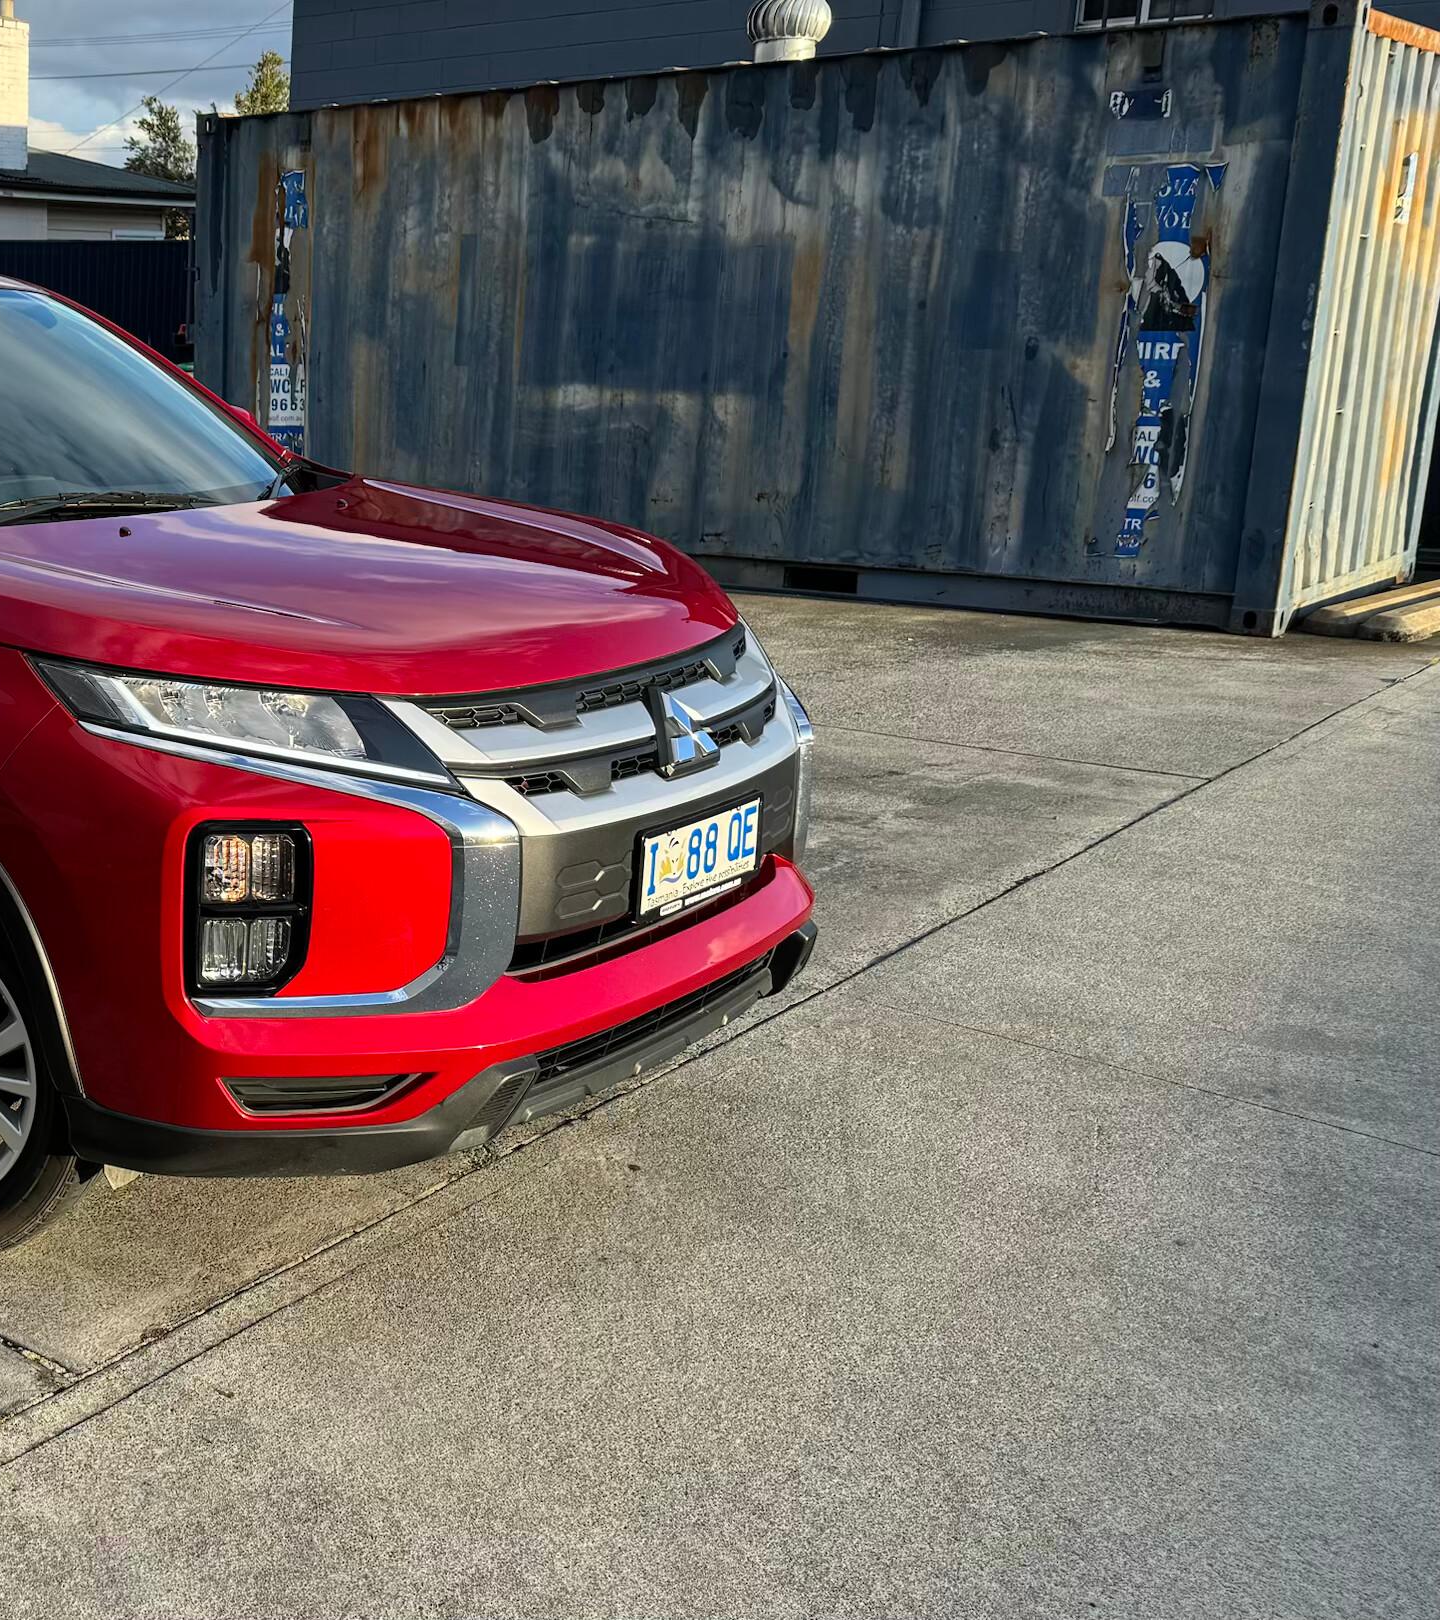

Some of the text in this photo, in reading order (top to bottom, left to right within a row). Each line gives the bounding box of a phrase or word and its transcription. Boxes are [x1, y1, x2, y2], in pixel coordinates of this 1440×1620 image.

[275, 323, 285, 337] &
[1143, 370, 1161, 388] &
[687, 822, 719, 880] 88
[647, 889, 679, 907] Tasmania
[682, 881, 704, 894] Explore
[706, 872, 718, 884] the
